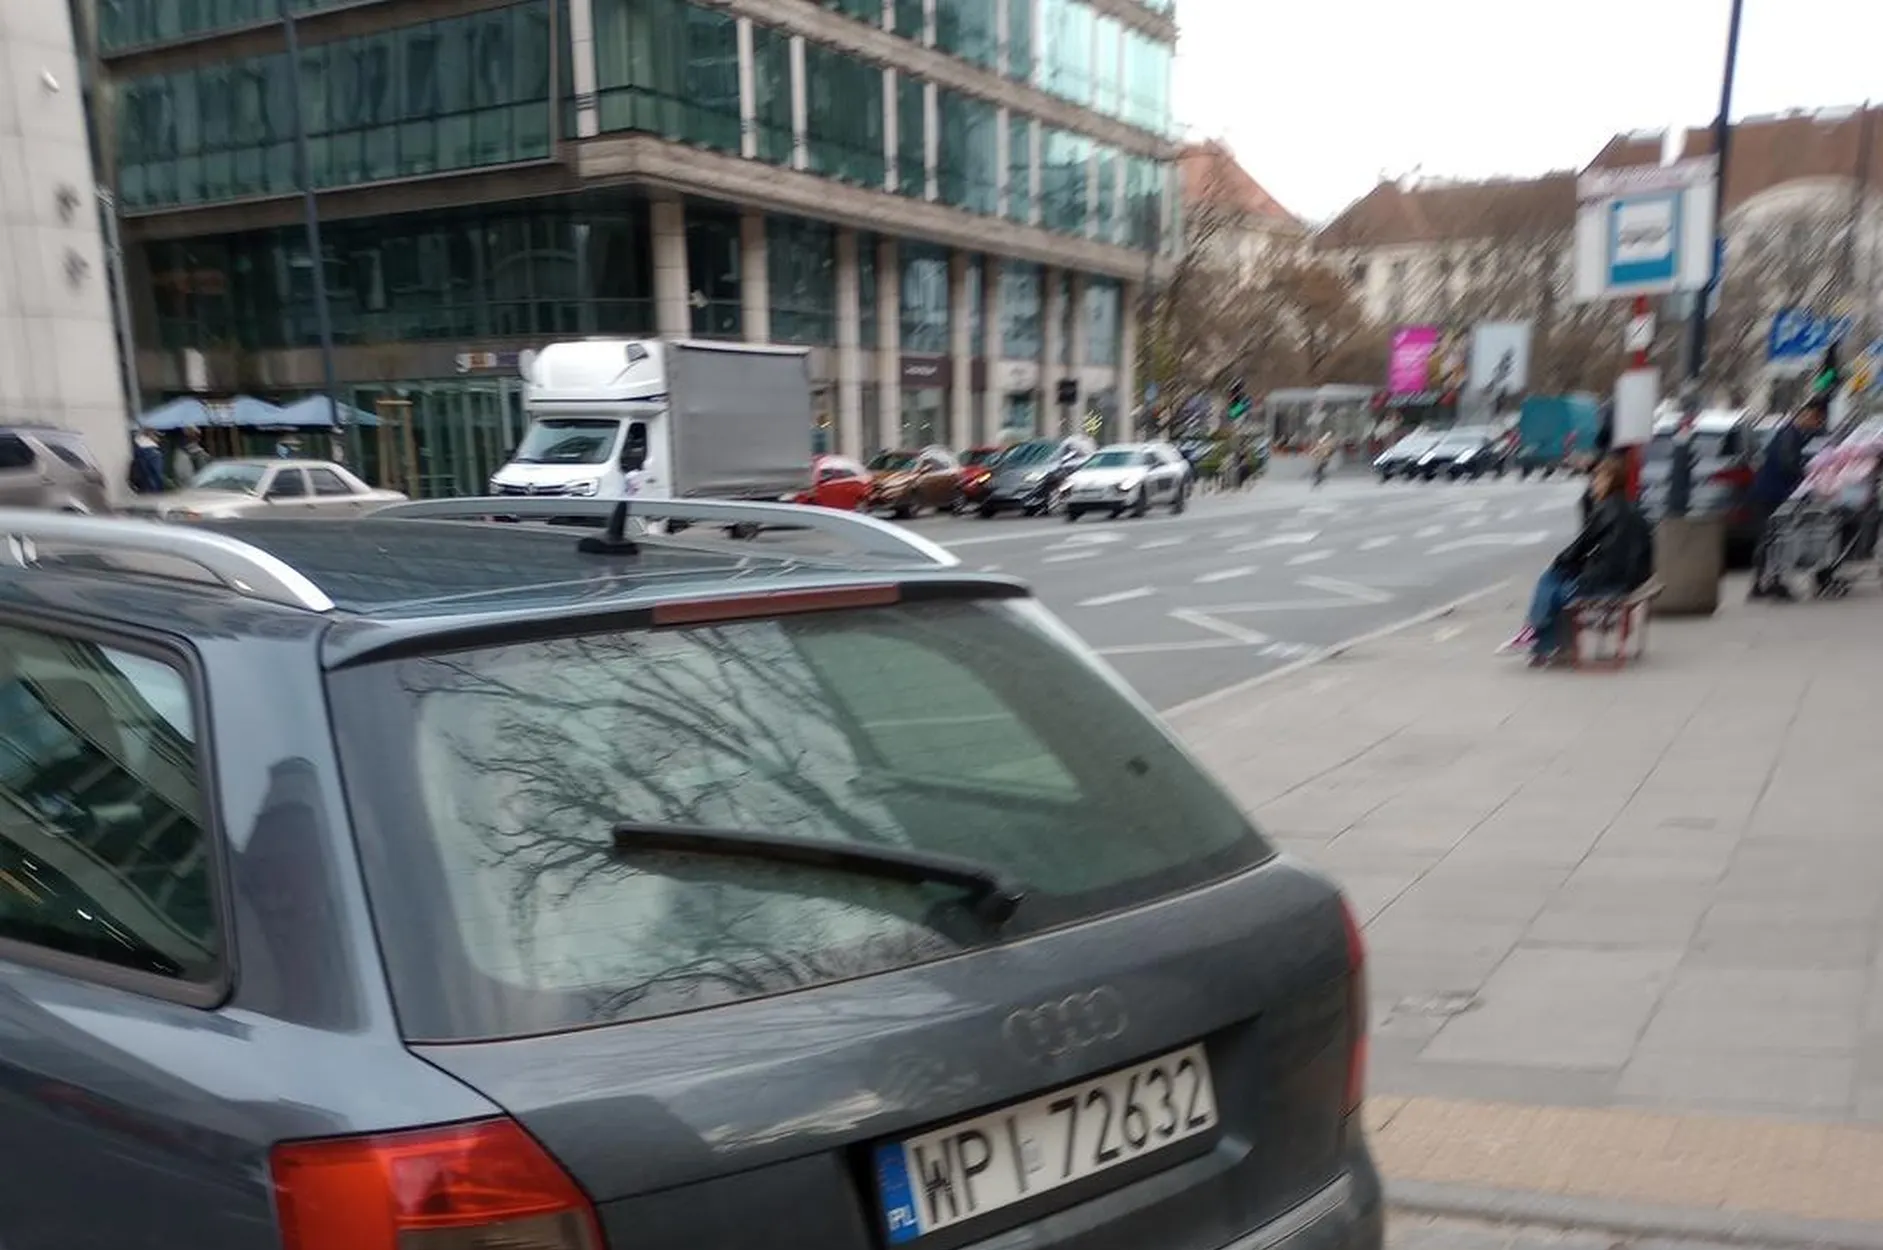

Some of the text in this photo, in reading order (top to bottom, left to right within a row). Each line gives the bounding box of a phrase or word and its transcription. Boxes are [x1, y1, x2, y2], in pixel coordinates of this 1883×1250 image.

[912, 1055, 1207, 1226] WPI 72632
[887, 1204, 916, 1232] PL
